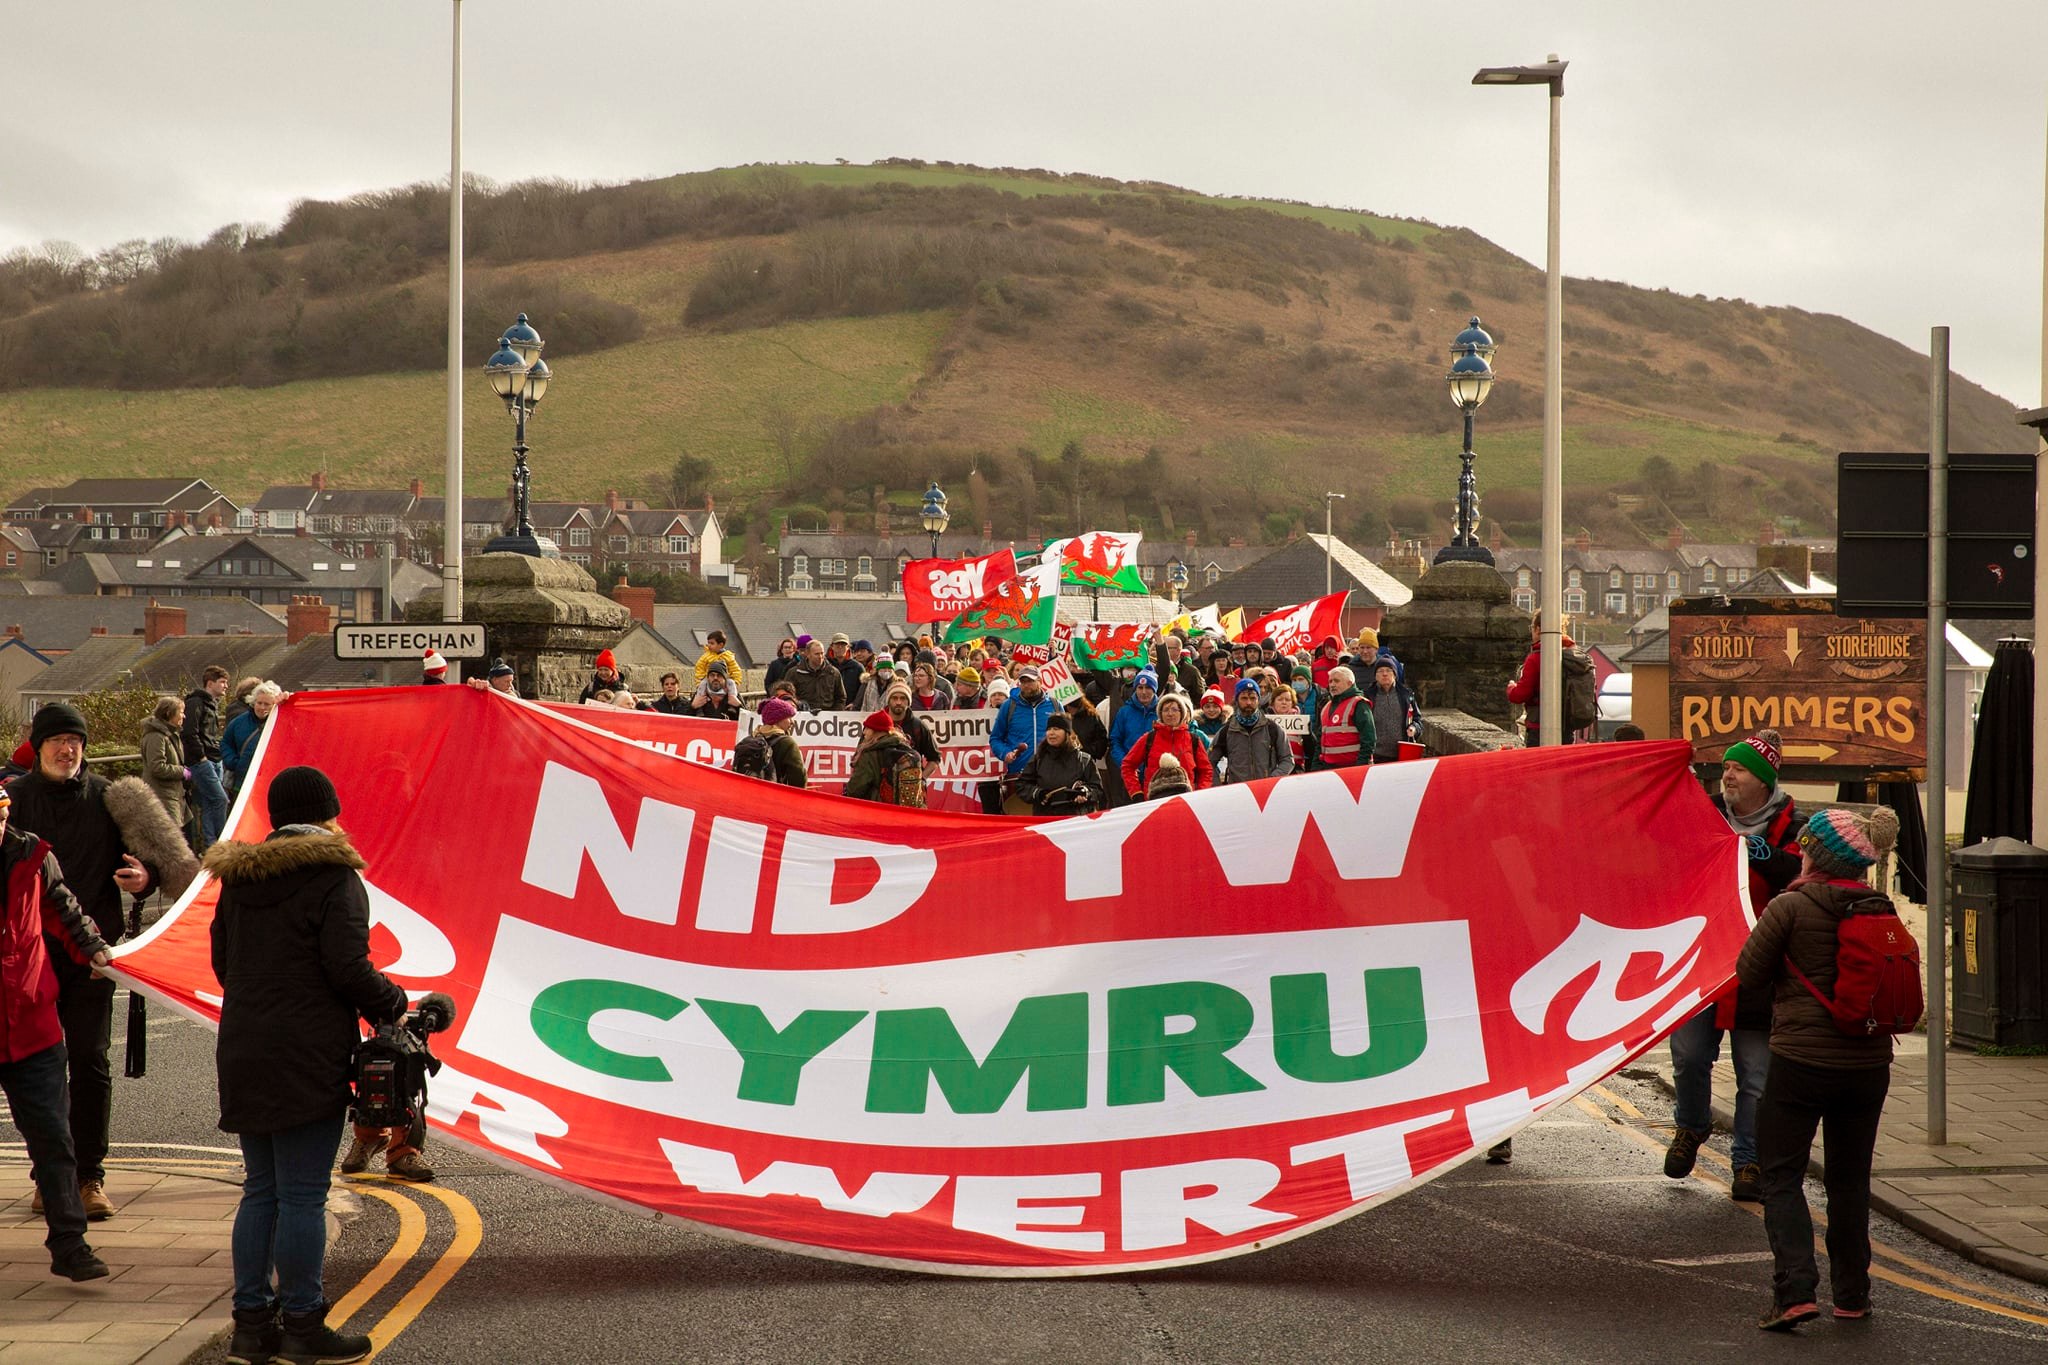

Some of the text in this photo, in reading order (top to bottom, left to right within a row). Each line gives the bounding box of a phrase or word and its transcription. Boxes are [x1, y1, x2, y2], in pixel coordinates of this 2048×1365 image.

[348, 632, 475, 650] TREFECHAN
[1016, 644, 1032, 657] AR
[1693, 636, 1755, 658] STORDY
[1826, 635, 1910, 658] STOREHOUSE
[1682, 695, 1915, 744] RUMMERS
[522, 759, 1439, 936] NID YW
[530, 966, 1429, 1115] CYMRU
